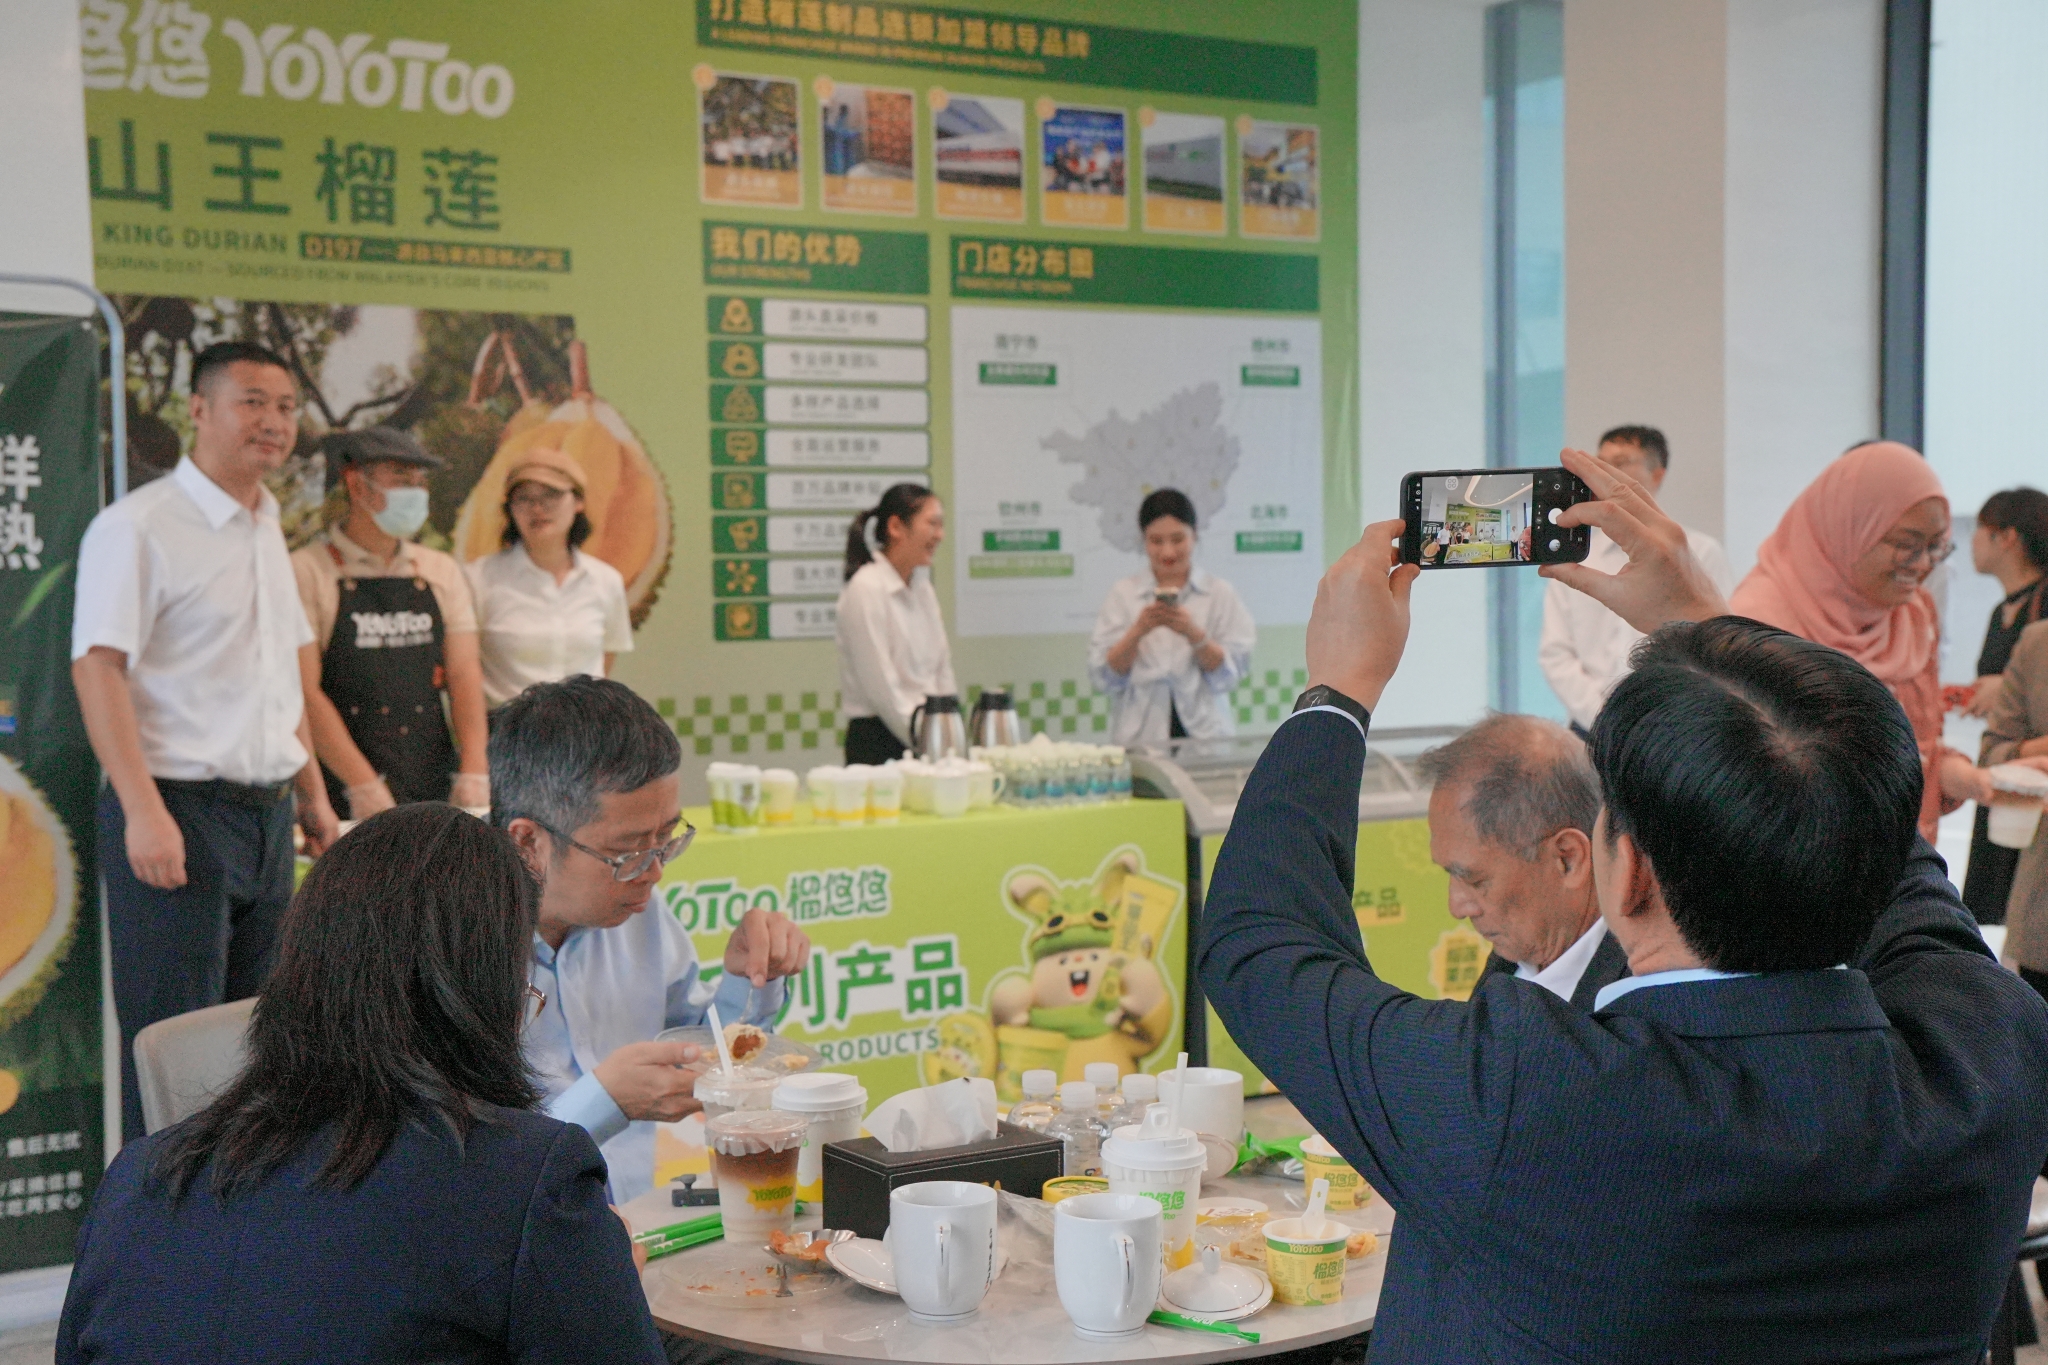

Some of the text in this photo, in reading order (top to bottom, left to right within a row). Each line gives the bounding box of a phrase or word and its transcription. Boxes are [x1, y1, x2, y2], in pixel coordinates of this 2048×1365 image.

[89, 118, 501, 232] 山王榴莲
[104, 224, 287, 252] KING DURIAN
[711, 226, 862, 266] 我们的优势
[958, 241, 1094, 279] 门店分布图
